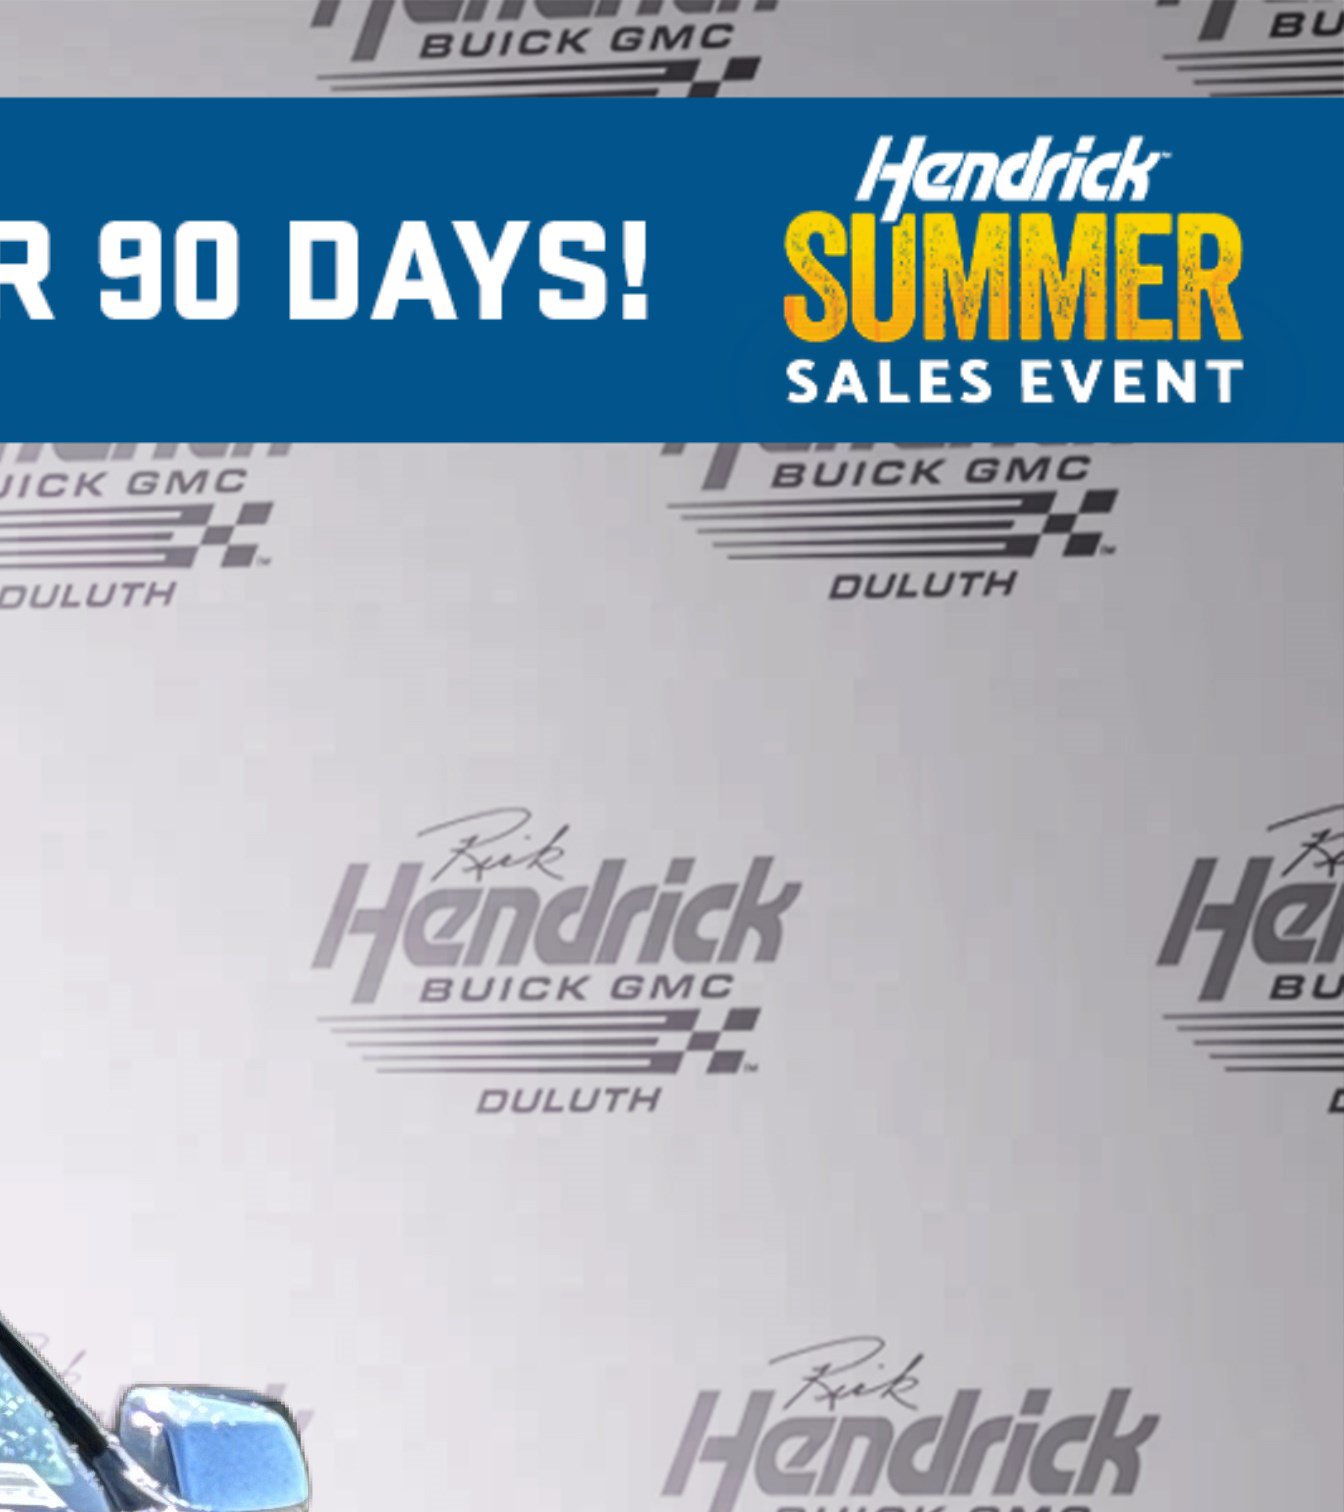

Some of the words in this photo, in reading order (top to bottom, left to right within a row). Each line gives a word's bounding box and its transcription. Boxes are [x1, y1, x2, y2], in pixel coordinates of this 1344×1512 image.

[419, 28, 592, 59] BUICK
[610, 24, 735, 52] GMC
[126, 468, 248, 497] GMC
[771, 458, 946, 489] BUICK
[965, 455, 1091, 484] GMC
[828, 570, 1018, 601] DULUTH
[310, 855, 803, 1005] Hendrick
[420, 975, 592, 1003] BUICK
[610, 973, 735, 1001] GMC
[476, 1087, 663, 1115] DULUTH
